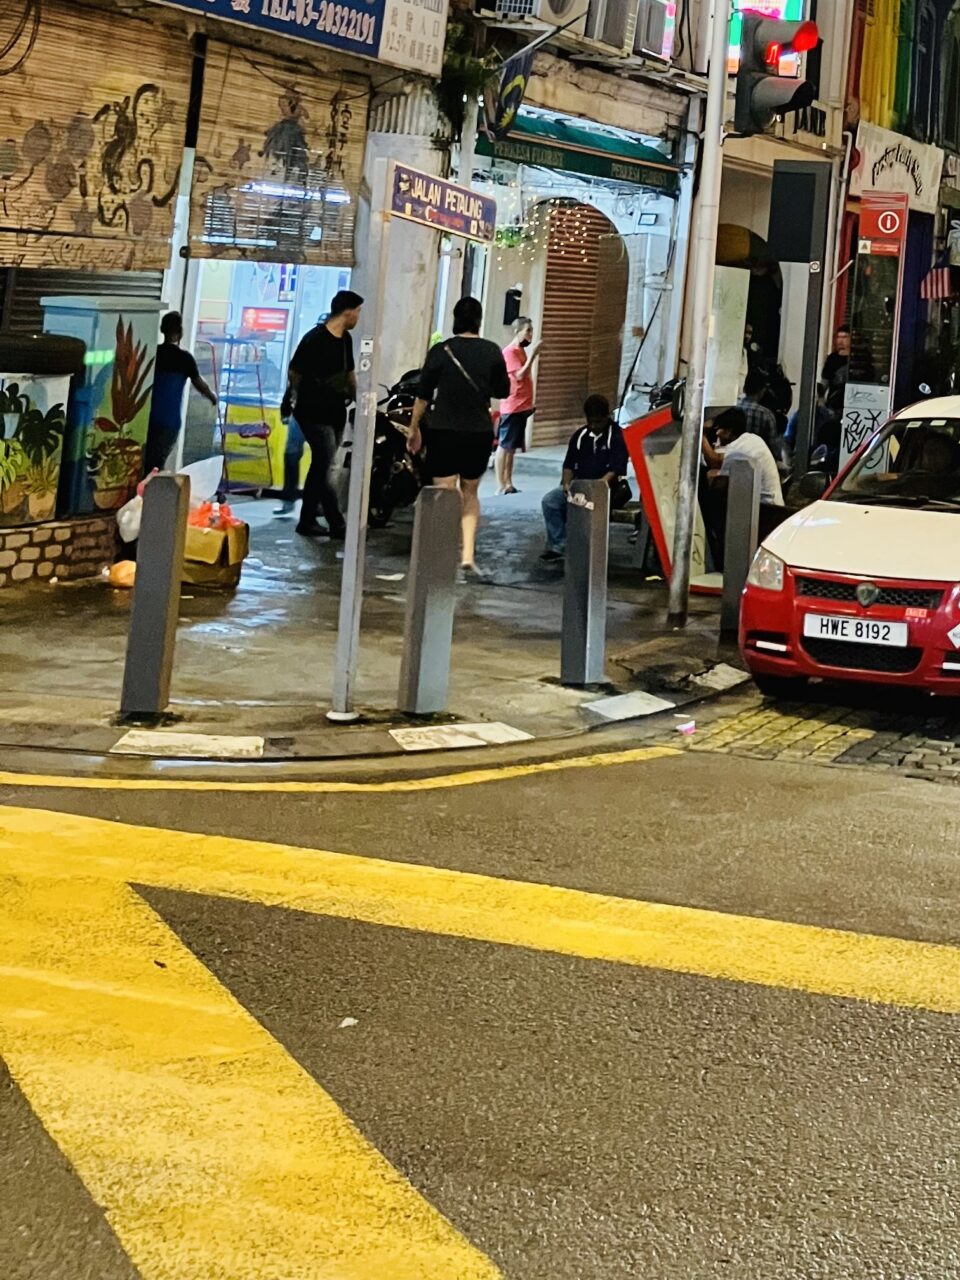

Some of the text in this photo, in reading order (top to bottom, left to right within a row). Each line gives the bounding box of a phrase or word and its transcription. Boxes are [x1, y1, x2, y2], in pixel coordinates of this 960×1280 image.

[411, 176, 442, 207] JALAN
[444, 188, 483, 221] PETALING
[819, 617, 892, 642] HWE 8192
